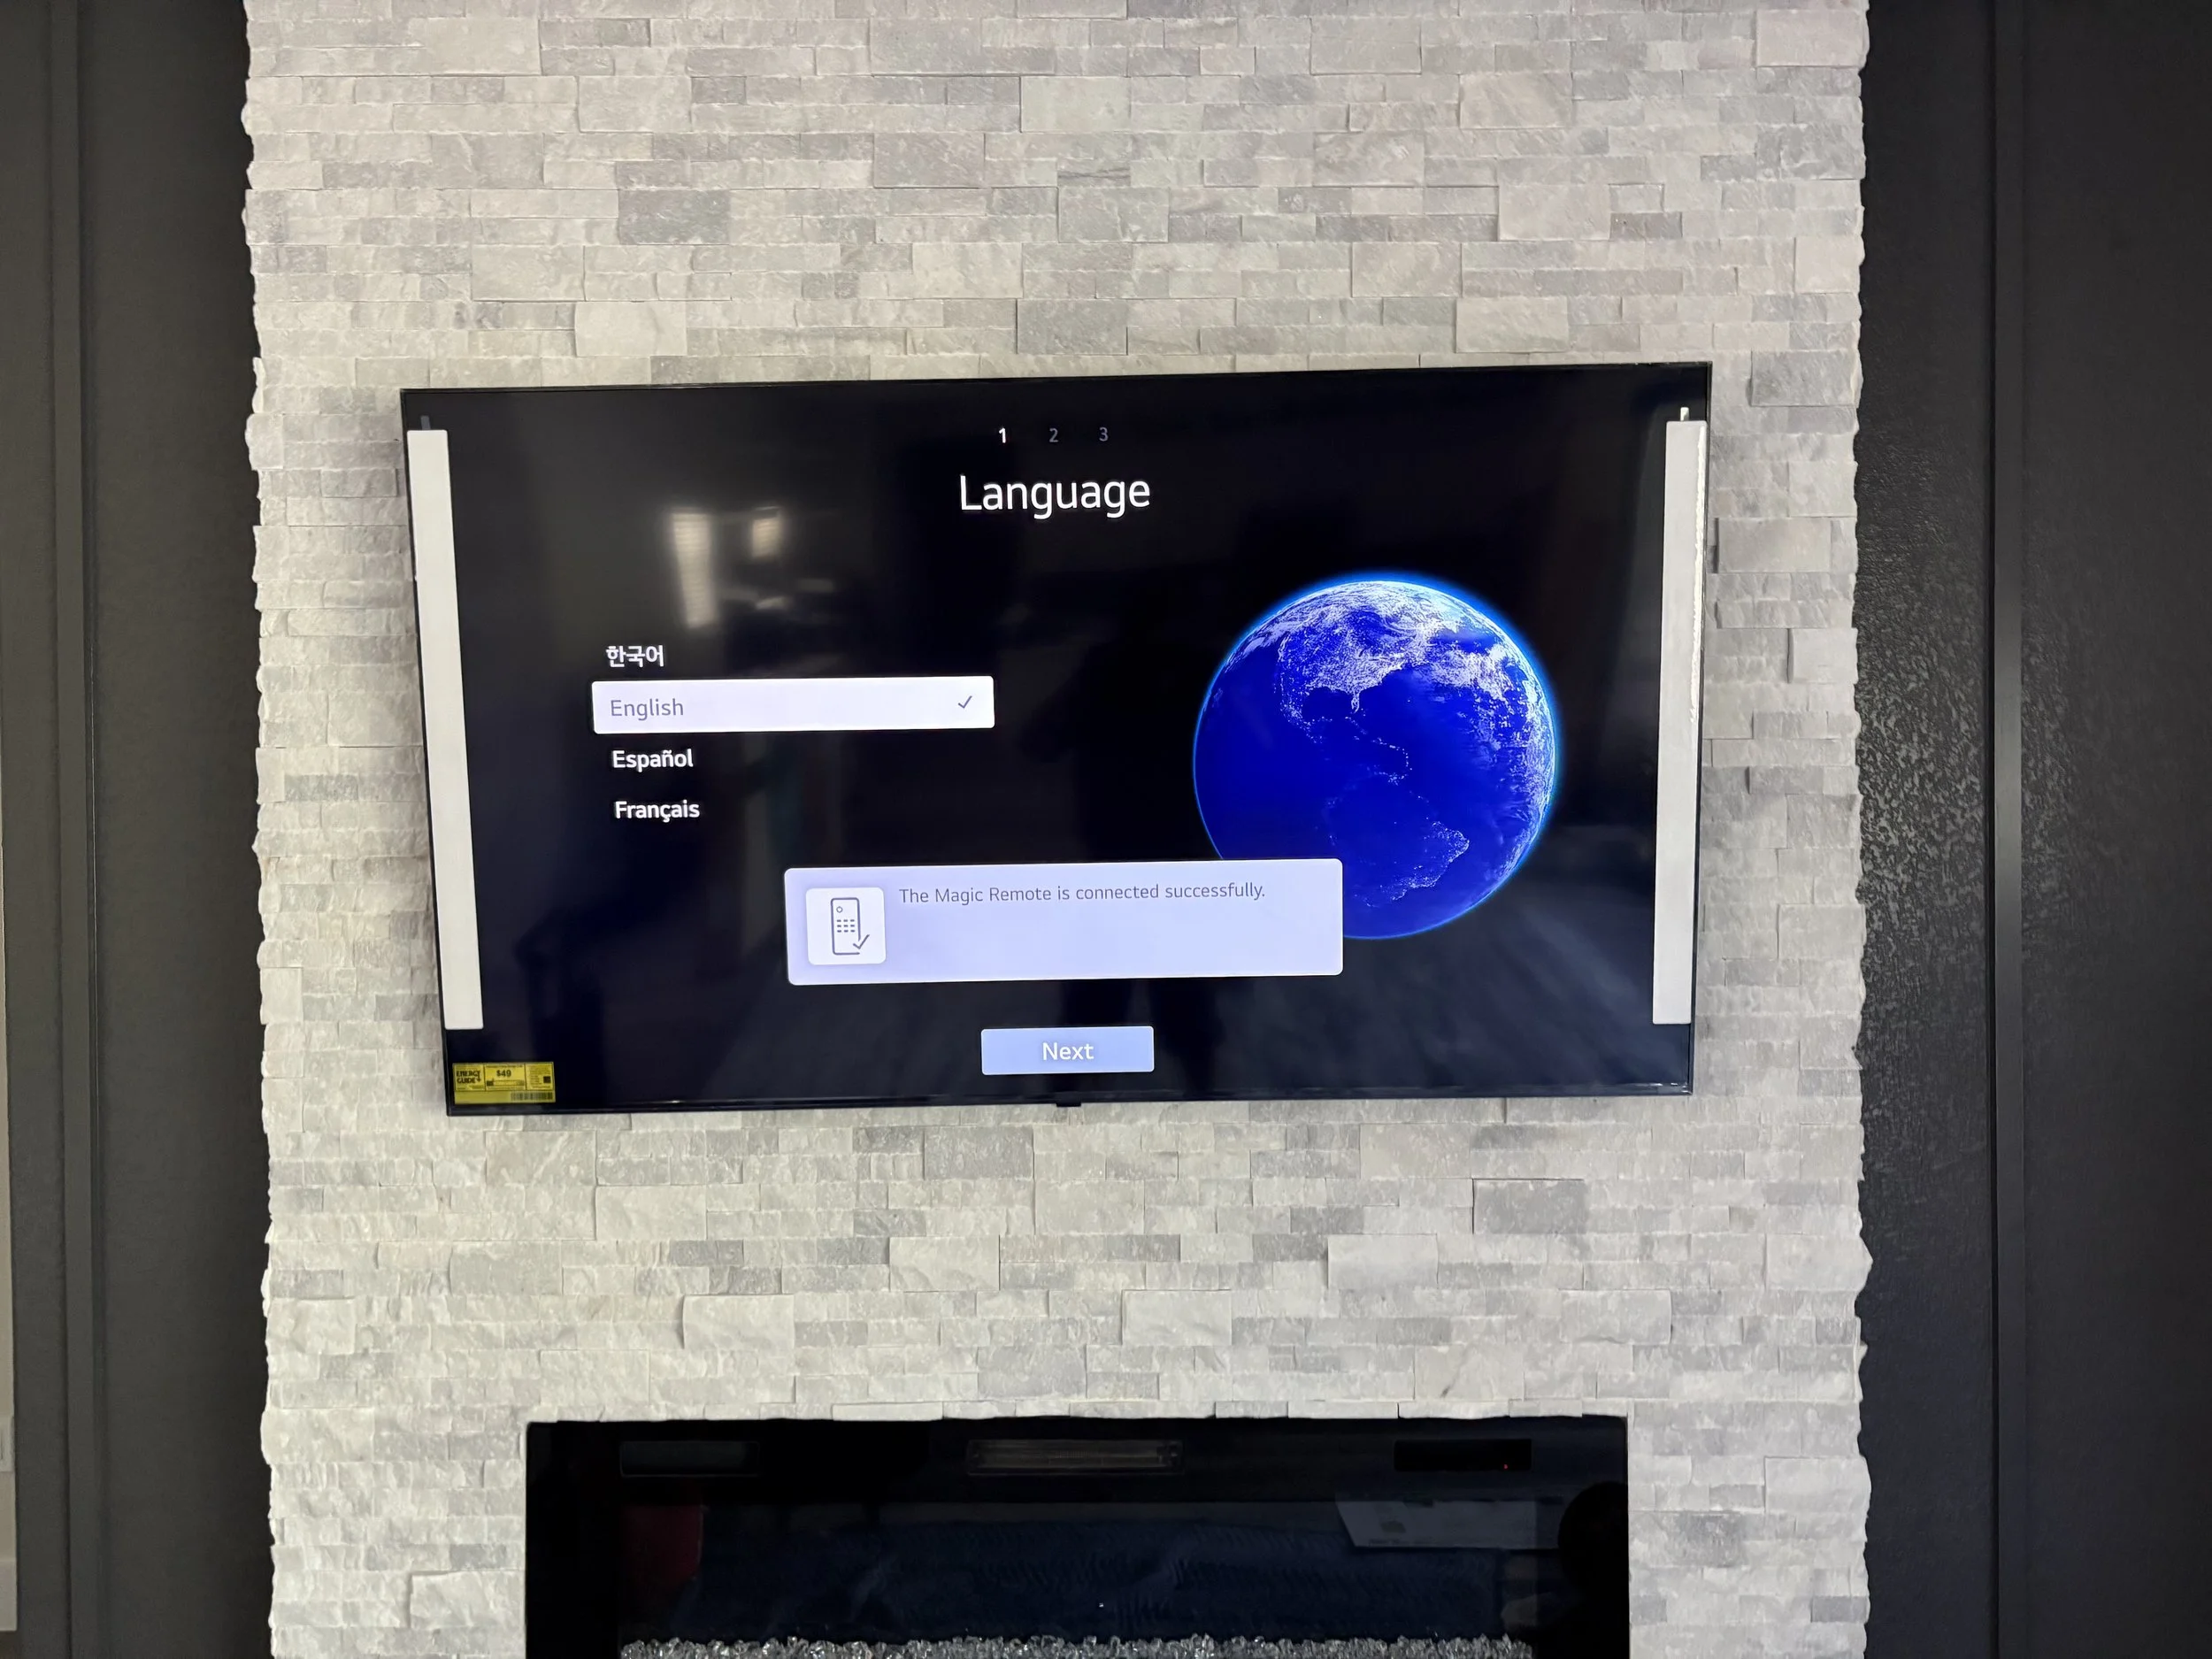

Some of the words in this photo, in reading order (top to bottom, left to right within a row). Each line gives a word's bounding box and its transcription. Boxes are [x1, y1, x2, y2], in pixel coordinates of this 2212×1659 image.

[998, 427, 1007, 443] 1
[1048, 427, 1059, 442] 2
[1099, 426, 1109, 442] 3
[960, 474, 1150, 519] Language
[605, 645, 664, 668] 한국어
[611, 698, 684, 721] English
[612, 749, 694, 772] Español
[615, 800, 700, 824] Français
[899, 887, 929, 903] The
[935, 887, 984, 906] Magic
[988, 886, 1052, 902] Remote
[1057, 885, 1070, 901] is
[1076, 883, 1160, 900] connected
[1164, 881, 1266, 901] successfully.
[1041, 1041, 1094, 1060] Next
